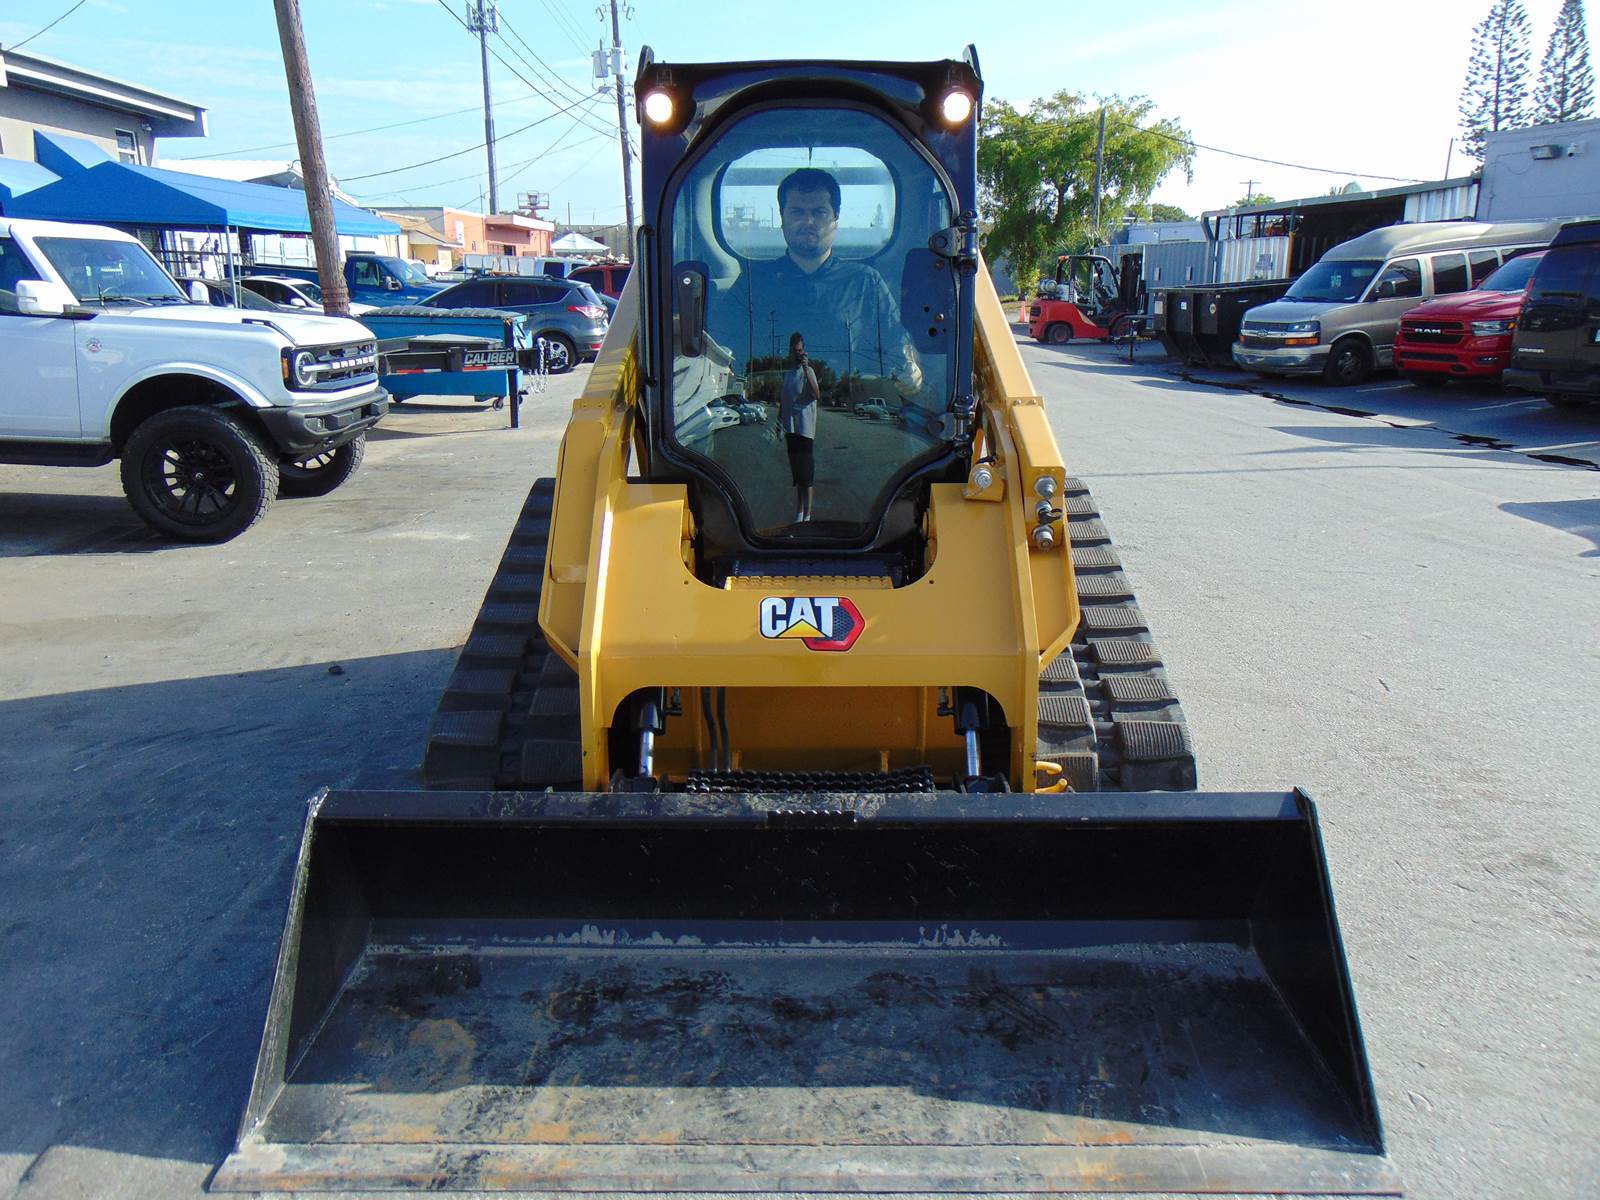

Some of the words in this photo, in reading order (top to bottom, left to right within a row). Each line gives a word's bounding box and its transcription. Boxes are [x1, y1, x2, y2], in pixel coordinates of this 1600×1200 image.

[332, 356, 374, 369] BRONCO
[464, 351, 514, 364] CALIBER
[761, 597, 839, 638] CAT
